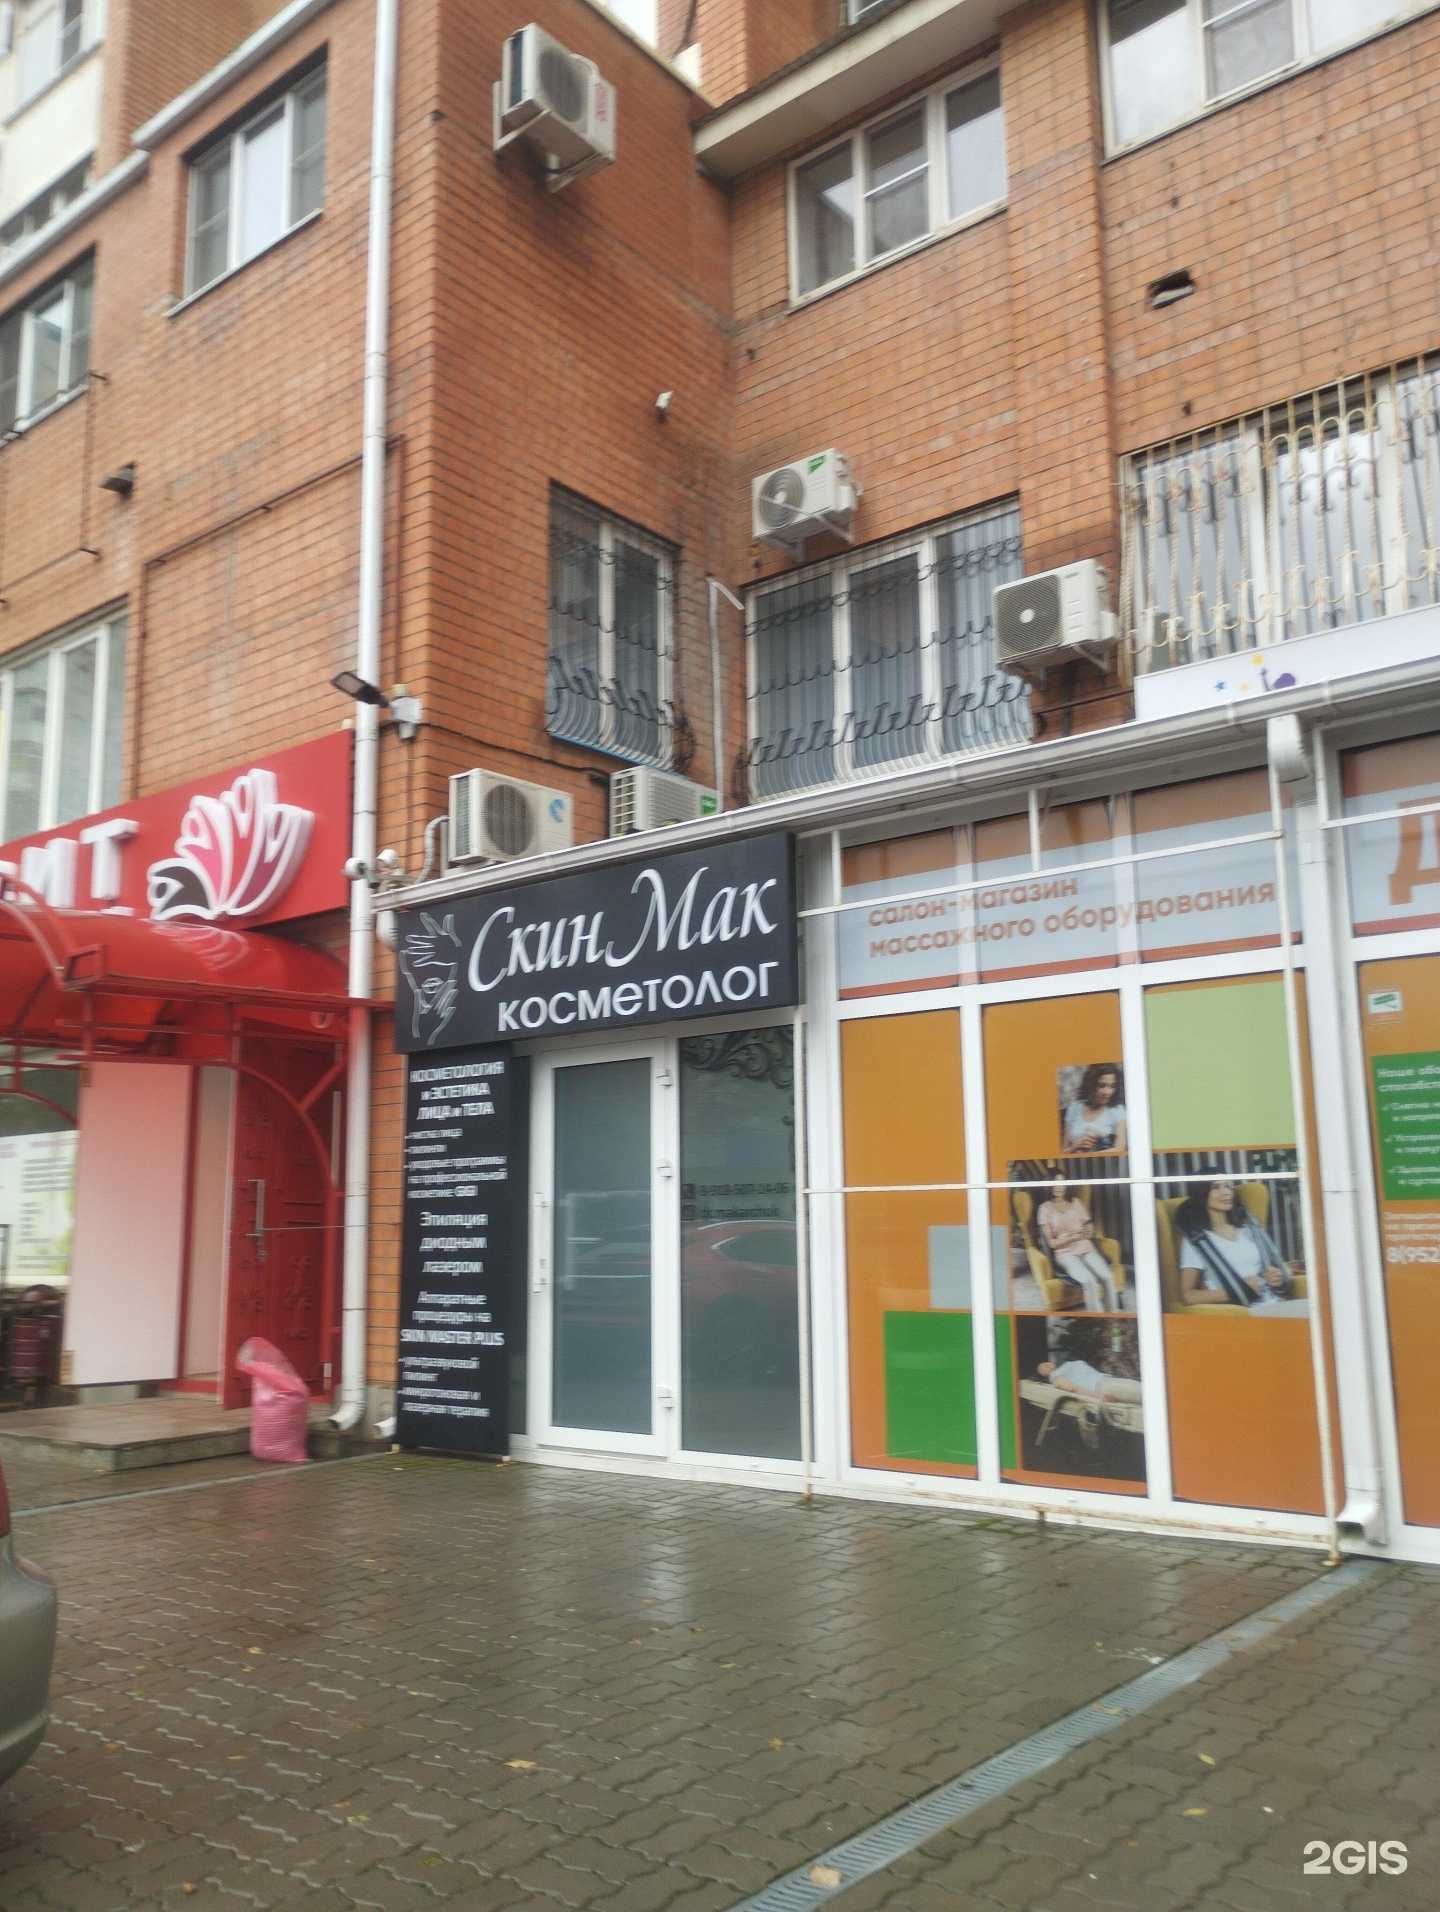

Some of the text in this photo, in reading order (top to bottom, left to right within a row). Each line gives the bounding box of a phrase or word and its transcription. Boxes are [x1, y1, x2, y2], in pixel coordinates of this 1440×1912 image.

[868, 878, 1079, 927] салон-магазин
[1044, 882, 1276, 933] оборудования
[468, 867, 778, 992] Скин Мак
